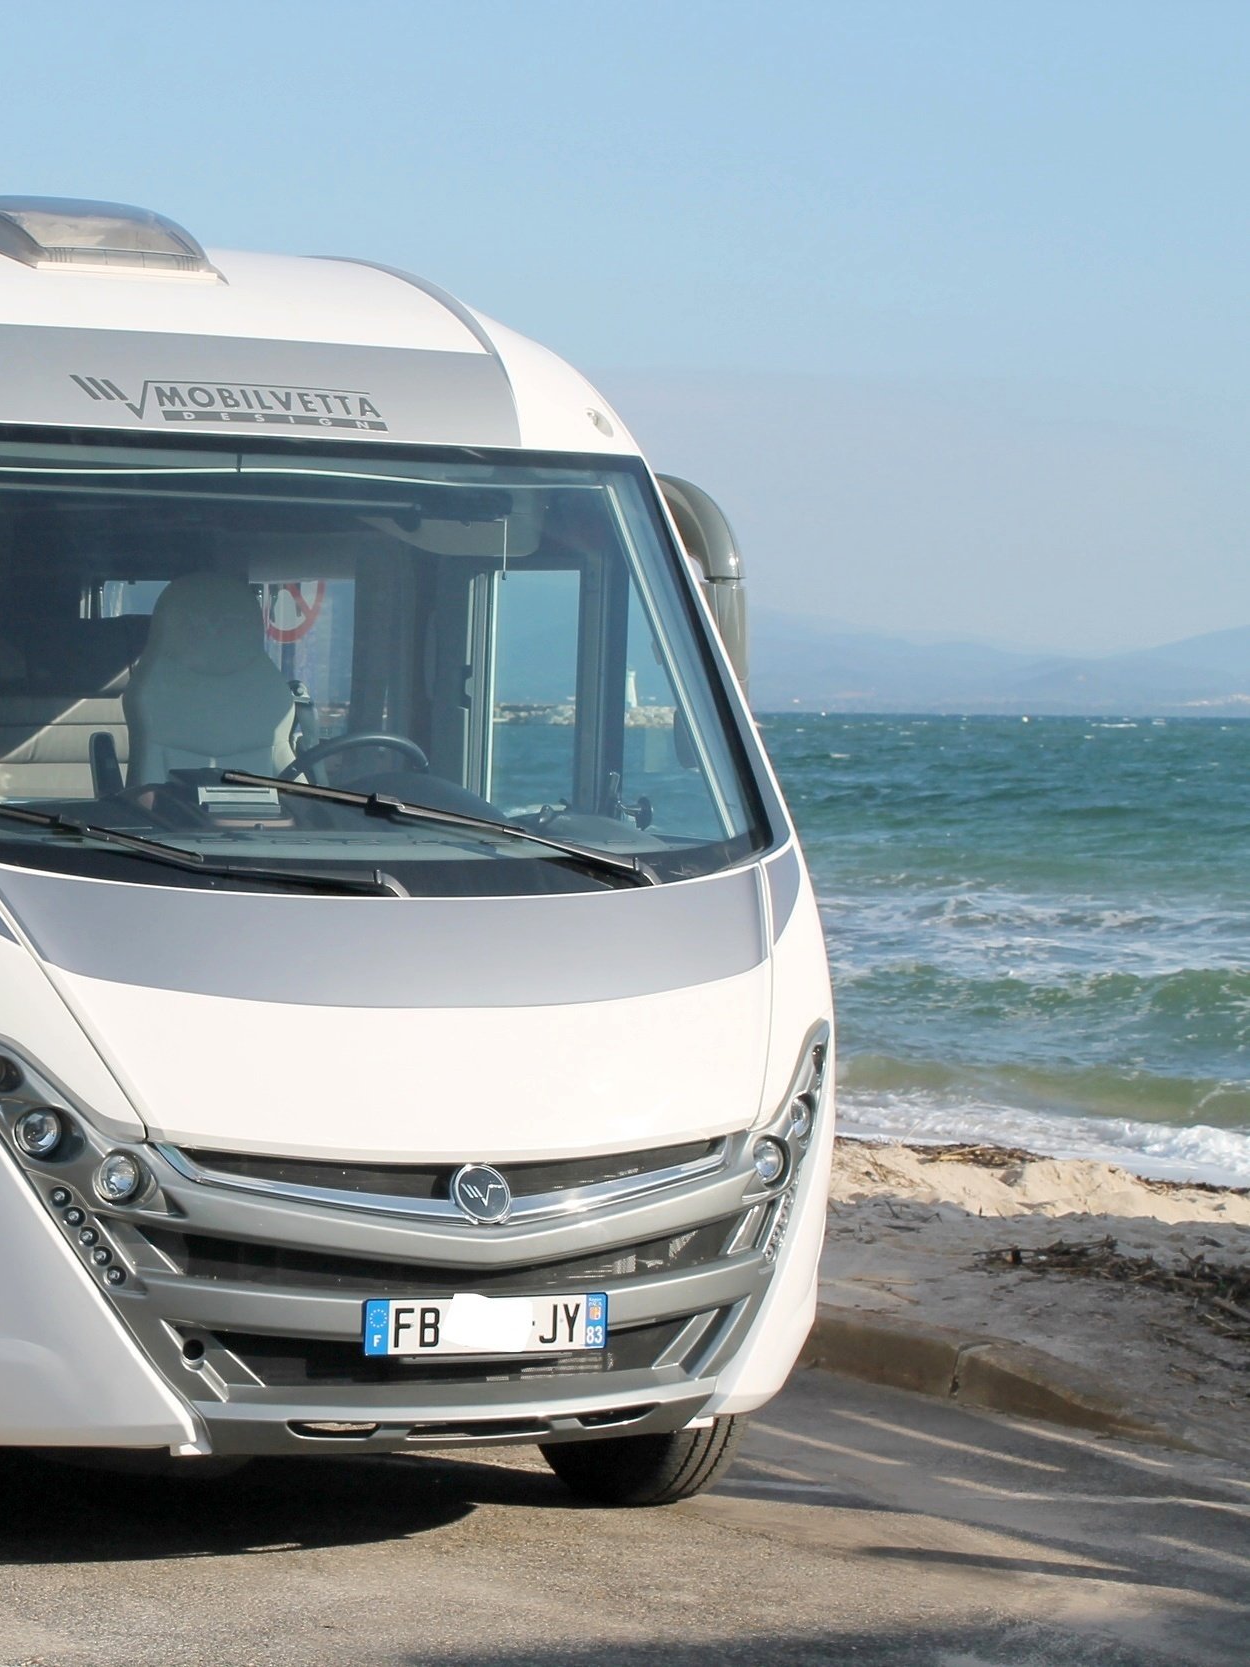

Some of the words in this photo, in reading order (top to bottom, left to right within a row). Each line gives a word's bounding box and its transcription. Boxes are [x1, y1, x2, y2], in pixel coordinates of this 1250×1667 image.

[154, 386, 382, 418] MOBILVETTA
[182, 411, 370, 430] DESIGN
[393, 1307, 440, 1348] FB
[586, 1325, 603, 1345] 83
[373, 1334, 382, 1347] F
